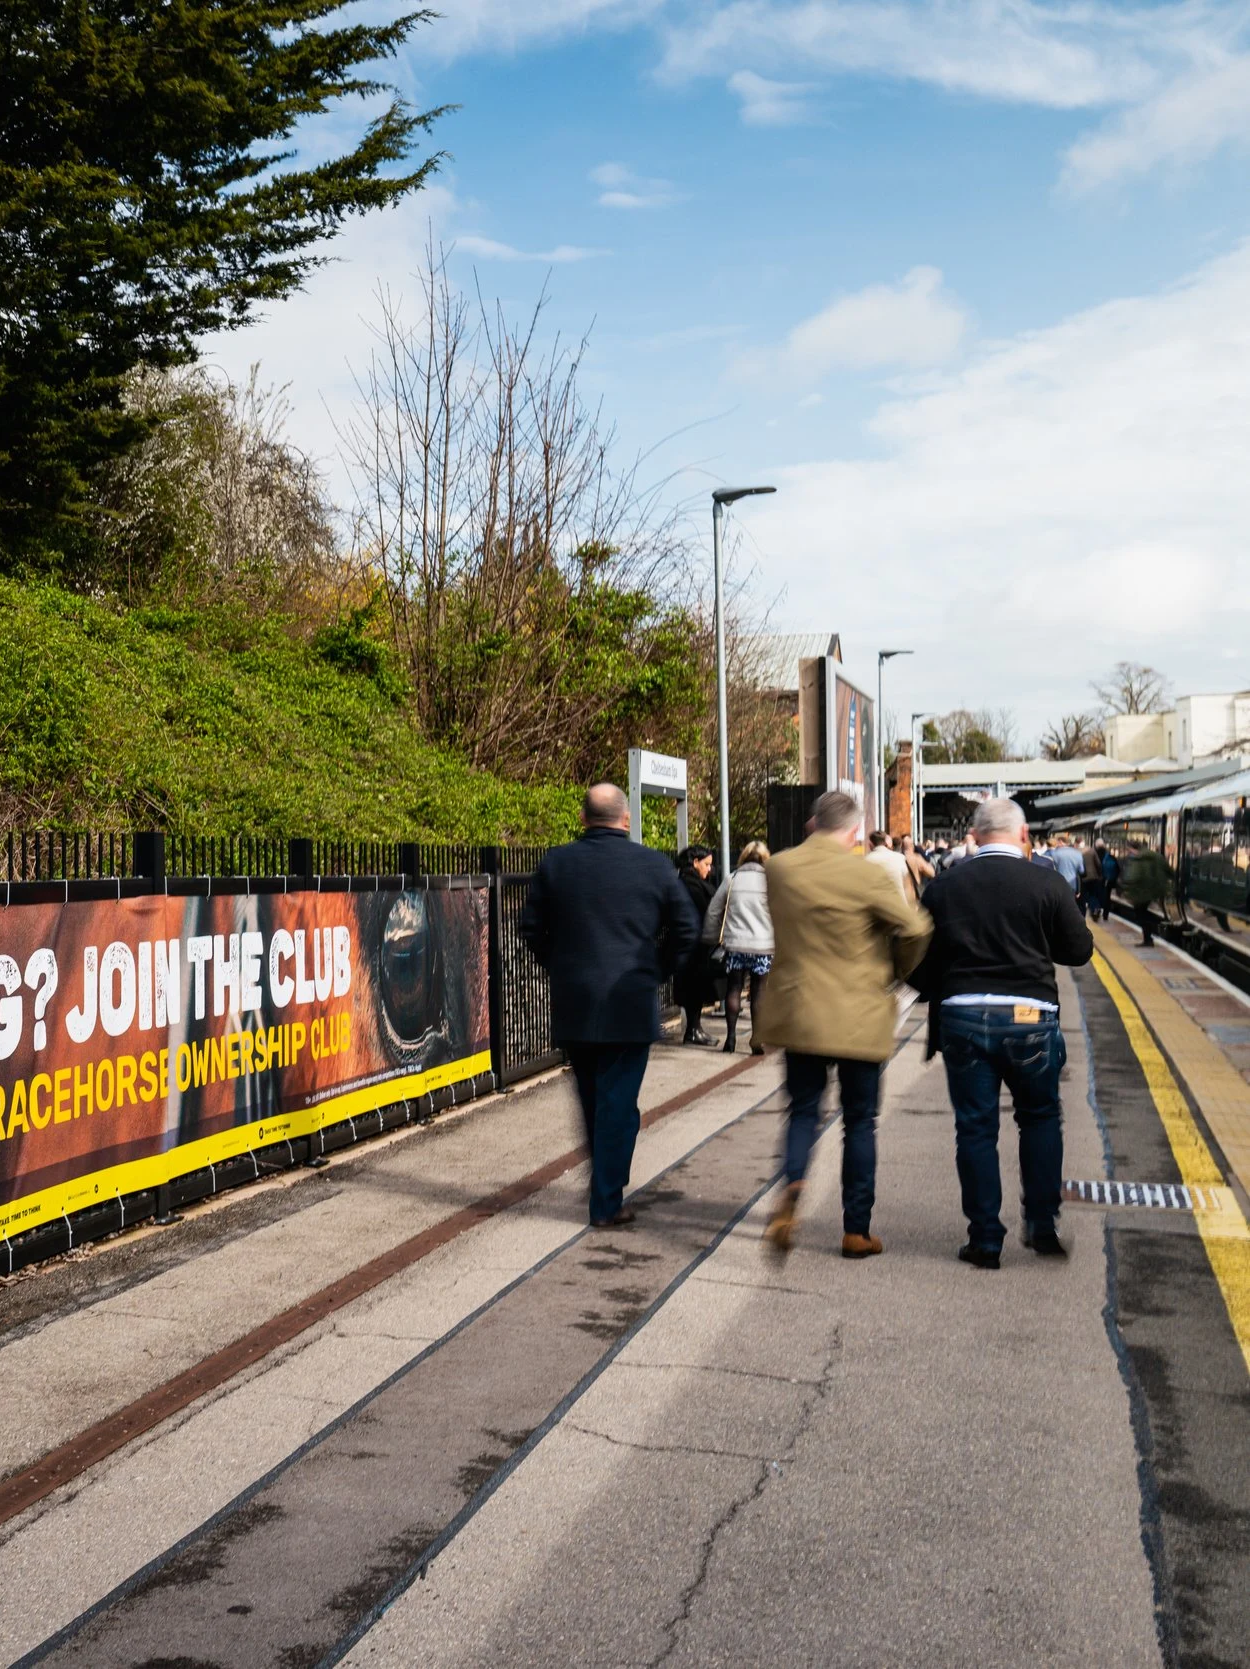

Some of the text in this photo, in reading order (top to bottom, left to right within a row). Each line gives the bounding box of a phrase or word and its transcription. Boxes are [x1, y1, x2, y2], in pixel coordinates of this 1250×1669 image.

[65, 938, 181, 1044] JOIN
[187, 931, 264, 1020] THE
[269, 925, 351, 1008] CLUB
[175, 1021, 307, 1093] OWNERSHIP
[310, 1011, 352, 1062] CLUB
[0, 1216, 10, 1227] TAKE
[11, 1211, 22, 1223] TIME
